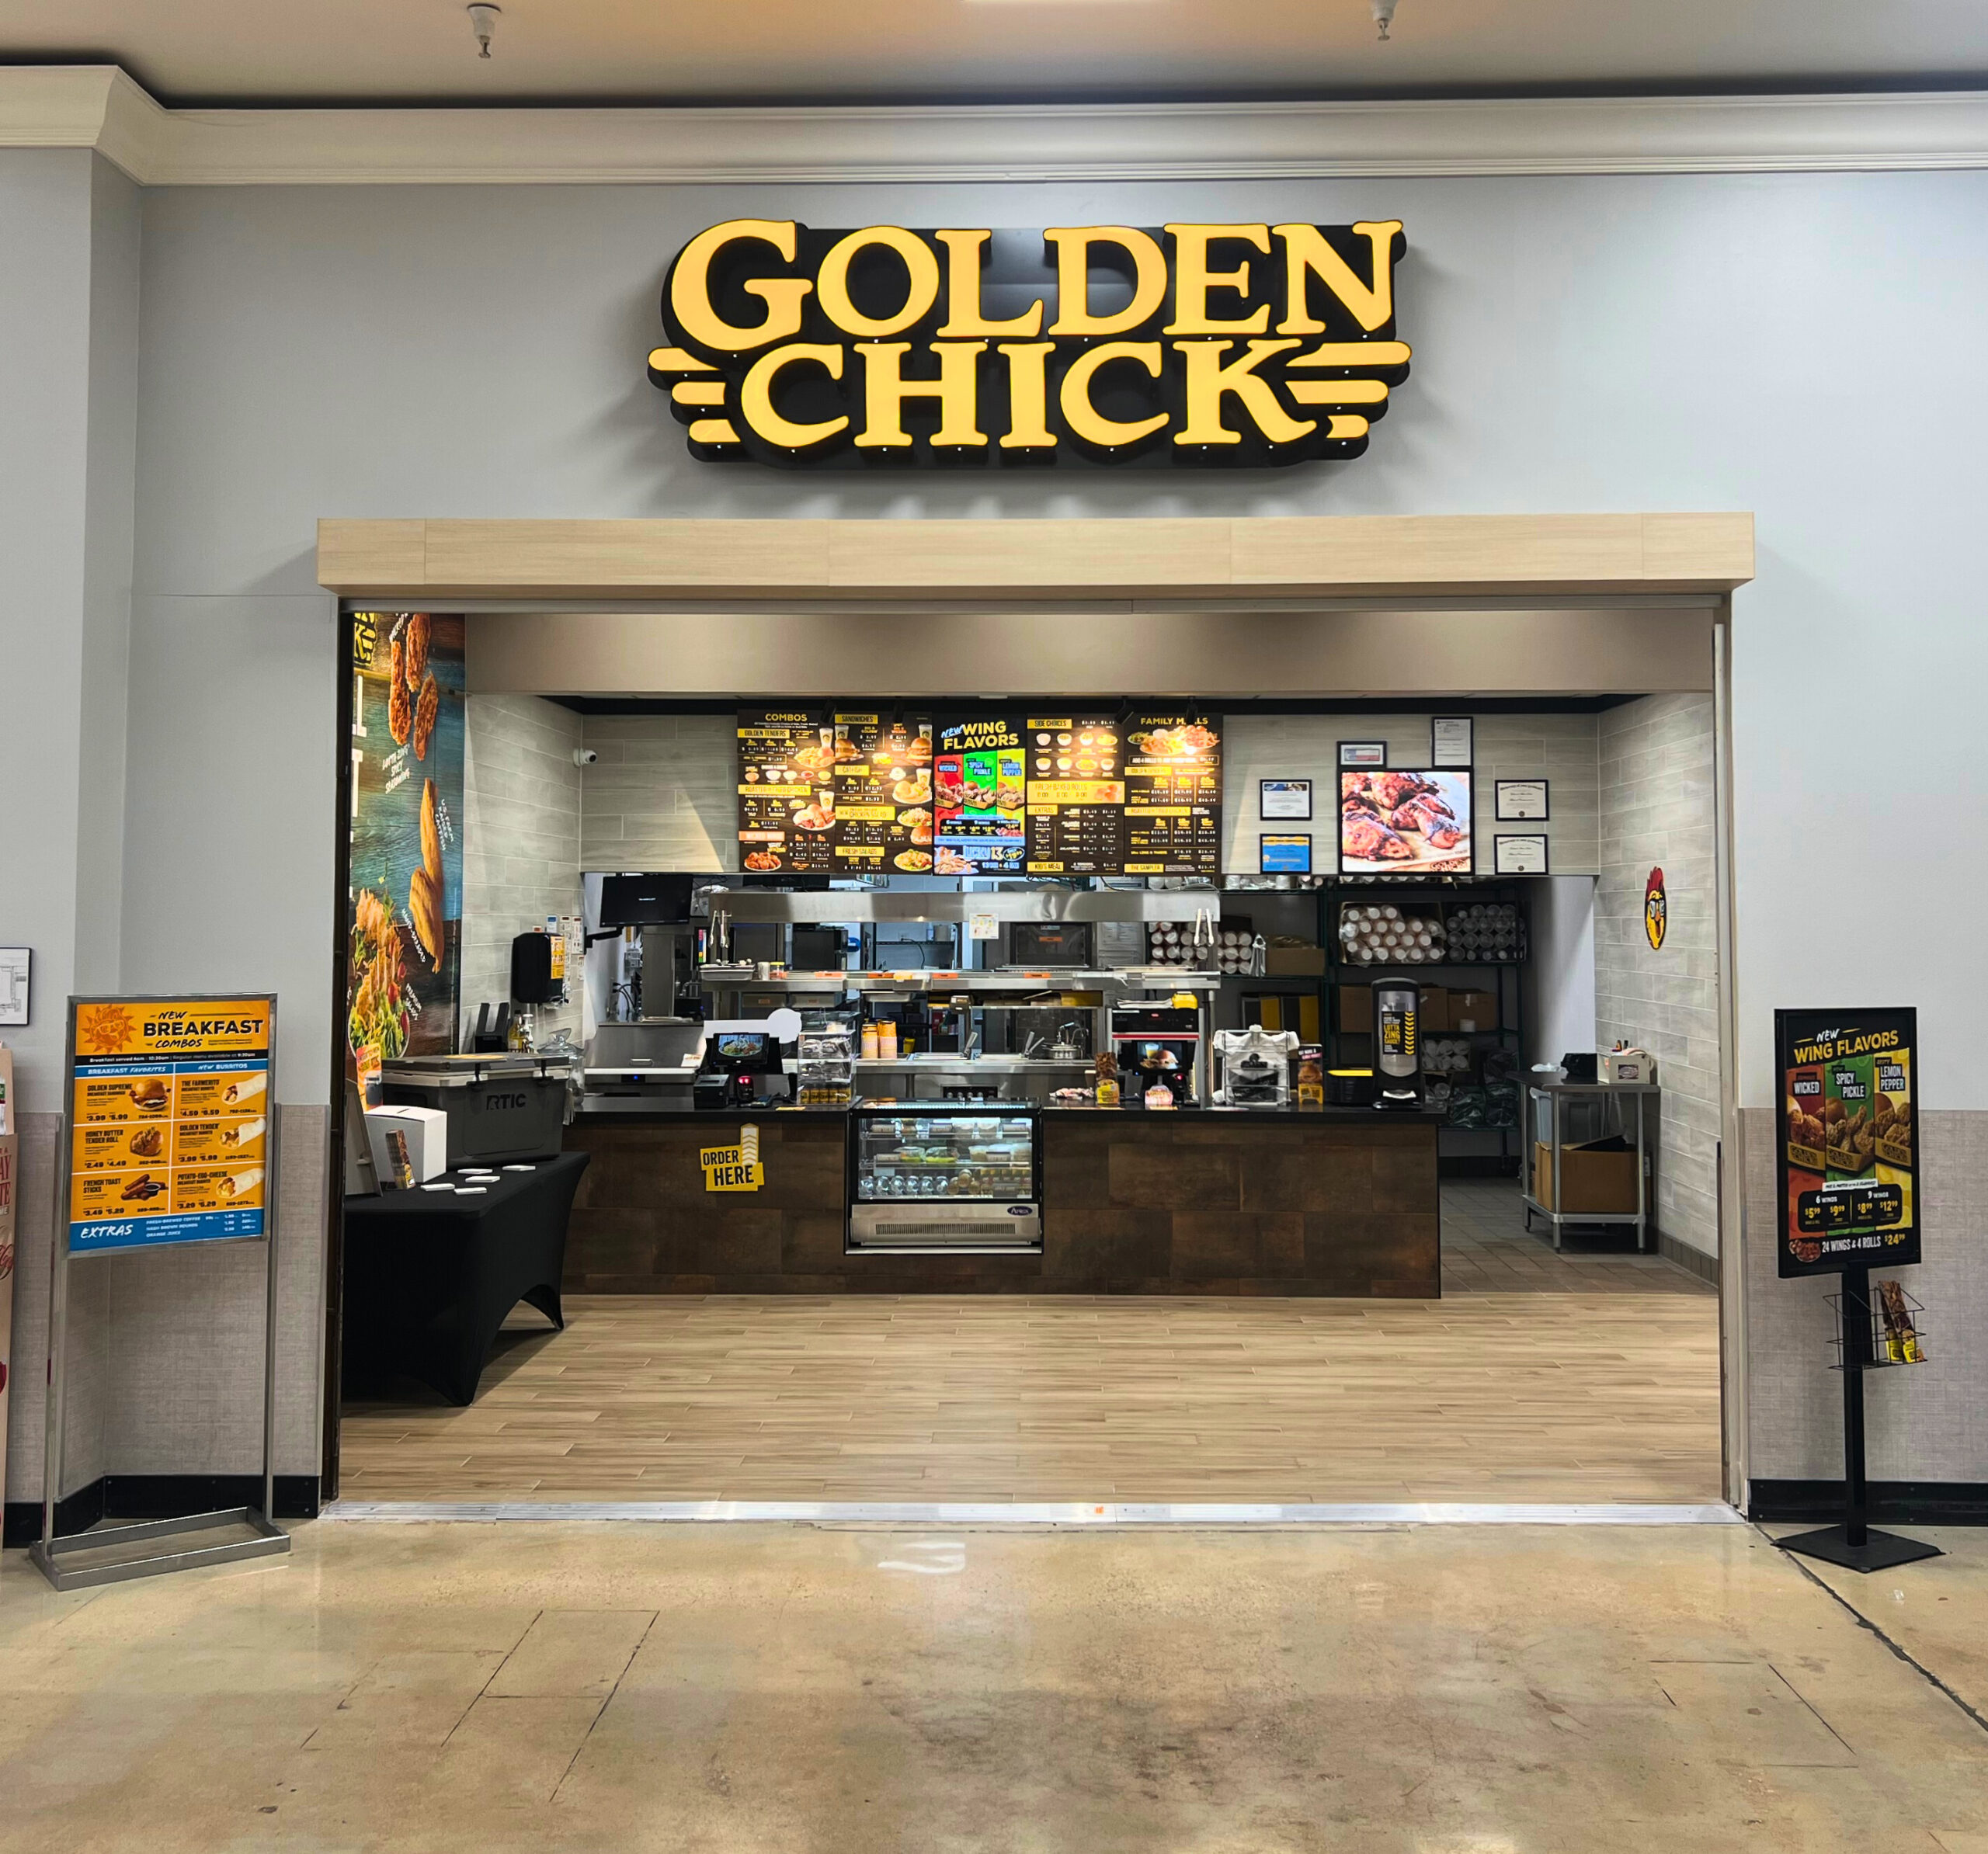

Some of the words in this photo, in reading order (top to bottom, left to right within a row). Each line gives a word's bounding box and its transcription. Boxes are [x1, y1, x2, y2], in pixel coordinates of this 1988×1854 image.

[671, 218, 1403, 352] GOLDEN
[741, 339, 1317, 448] CHICK
[765, 713, 808, 722] COMBOS
[941, 724, 963, 738] NEW
[963, 720, 1006, 736] WING
[944, 733, 1020, 751] FLAVORS
[991, 847, 1003, 860] 13
[158, 1011, 188, 1020] NEW
[144, 1019, 263, 1037] BREAKFAST
[1816, 1028, 1840, 1043] NEW
[155, 1038, 203, 1048] COMBOS
[1794, 1043, 1833, 1064] WING
[1837, 1030, 1899, 1056] FLAVORS
[1880, 1065, 1901, 1077] LEMON
[1836, 1073, 1855, 1085] SPICY
[1880, 1078, 1904, 1090] PEPPER
[1794, 1082, 1819, 1094] WICKED
[1842, 1086, 1865, 1098] PICKLE
[486, 1093, 527, 1110] RTIC
[703, 1150, 739, 1165] ORDER
[714, 1165, 754, 1186] HERE
[80, 1224, 134, 1238] EXTRAS
[1822, 1241, 1830, 1253] 24
[1830, 1239, 1851, 1252] WINGS
[1857, 1238, 1861, 1248] 4
[1863, 1236, 1881, 1248] ROLLS
